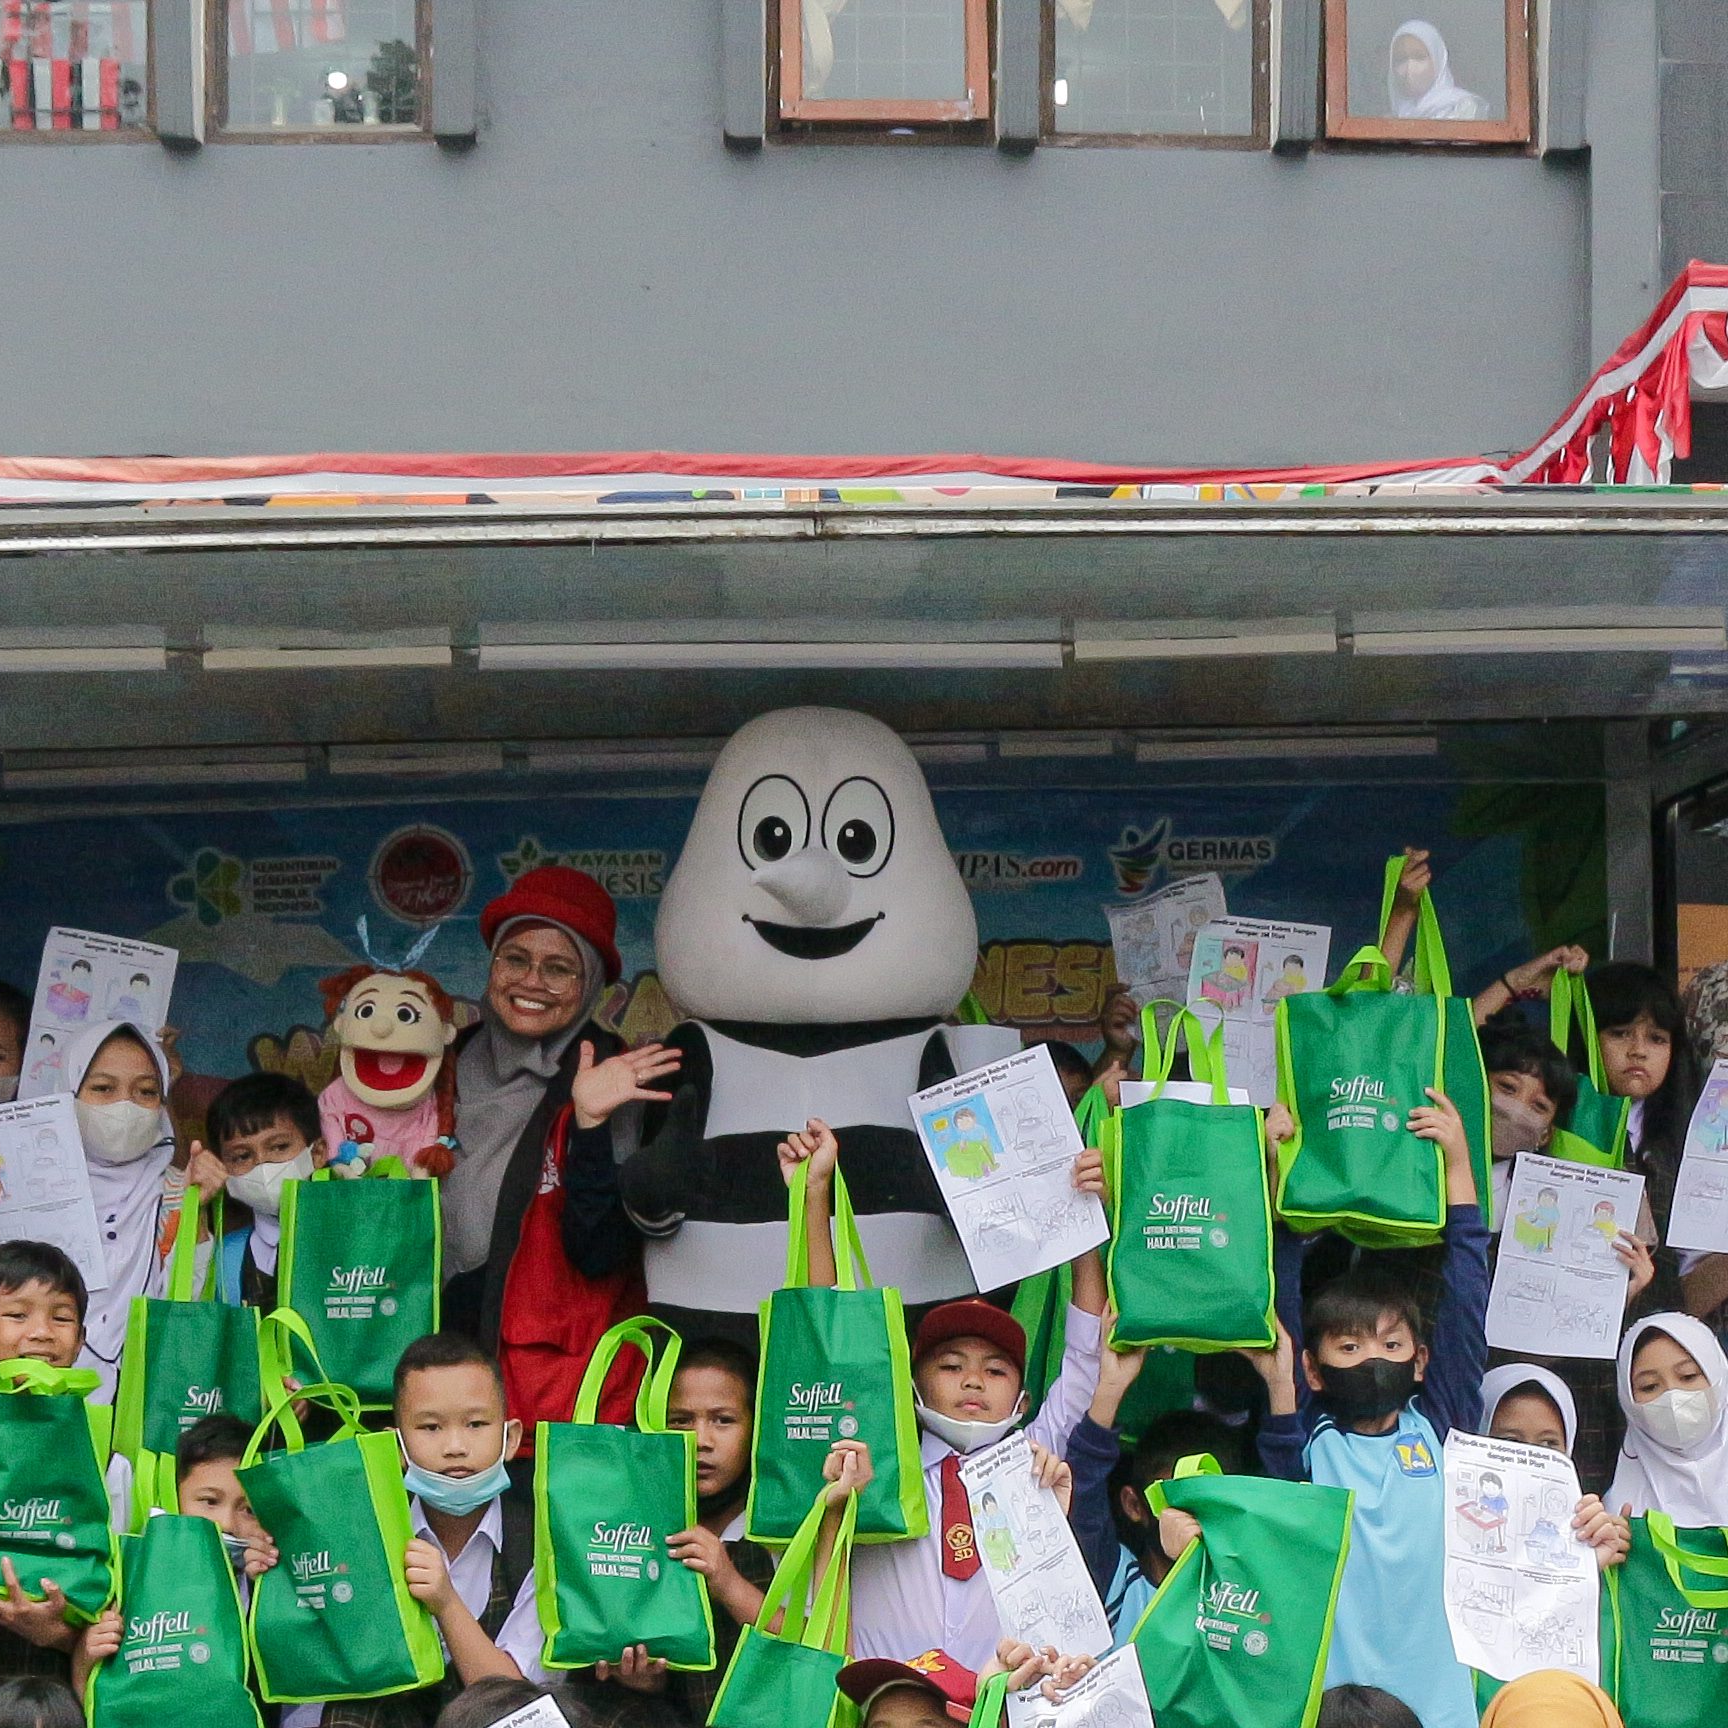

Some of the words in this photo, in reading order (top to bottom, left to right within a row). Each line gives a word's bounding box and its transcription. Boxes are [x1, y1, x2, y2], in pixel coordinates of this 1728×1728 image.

[1168, 842, 1271, 862] GERMAS
[1329, 1075, 1385, 1103] Soffell
[1149, 1193, 1211, 1223] Soffell
[330, 1264, 387, 1295] Soffell
[788, 1382, 843, 1413] Soffell
[0, 1498, 61, 1530] Soffell
[591, 1521, 652, 1553] Soffell
[953, 1547, 974, 1562] SD
[128, 1611, 189, 1644] Soffell
[1656, 1607, 1717, 1637] Soffell
